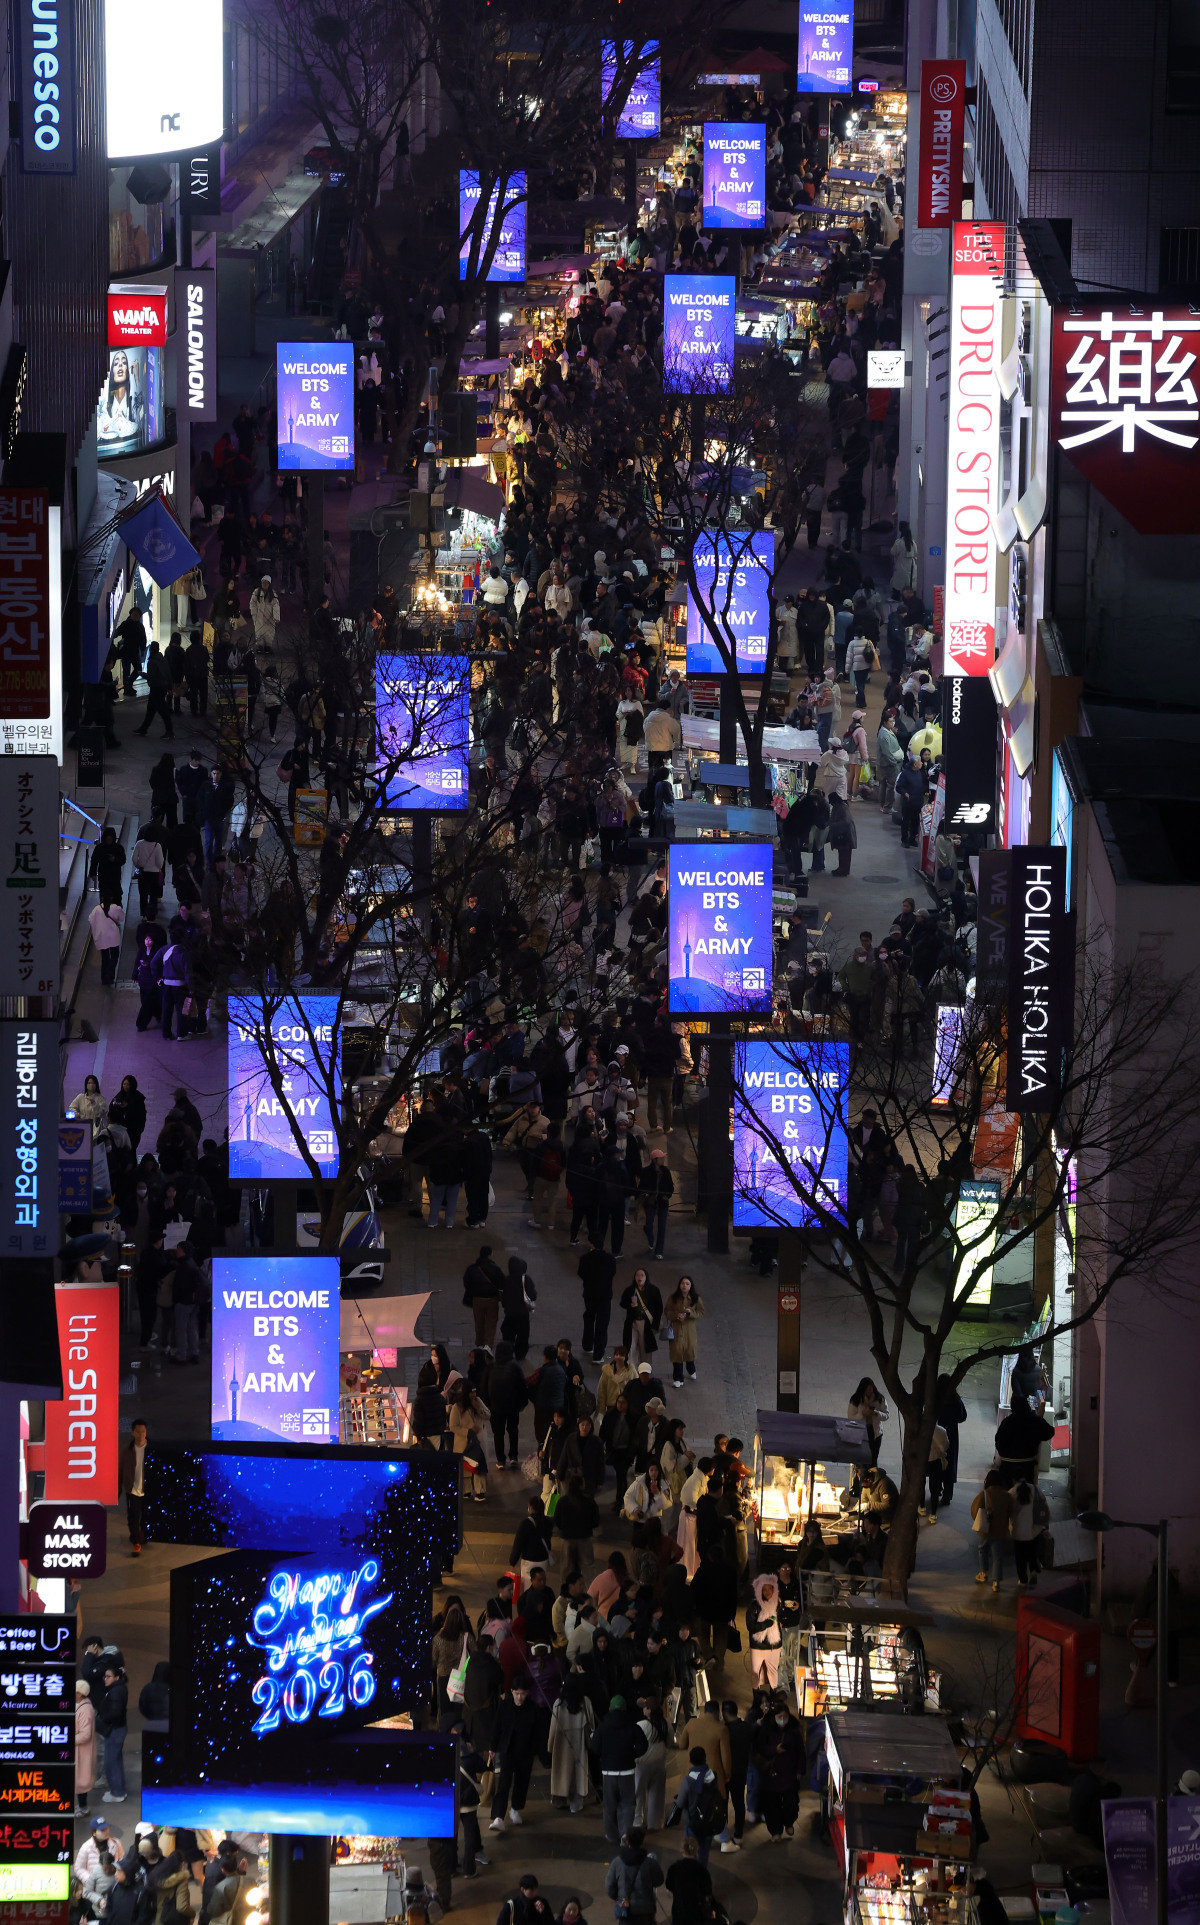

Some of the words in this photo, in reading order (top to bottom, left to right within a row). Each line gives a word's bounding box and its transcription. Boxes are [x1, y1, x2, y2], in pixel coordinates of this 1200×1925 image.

[803, 14, 850, 24] WELCOME
[816, 25, 836, 36] BTS
[822, 38, 830, 49] &
[810, 51, 843, 62] ARMY
[708, 139, 761, 150] WELCOME
[723, 152, 746, 164] BTS
[931, 109, 952, 219] PRETTYSKIN.
[190, 154, 209, 200] URY
[729, 167, 739, 179] &
[718, 181, 754, 193] ARMY
[963, 234, 993, 248] THE
[955, 249, 1003, 262] SEOUL
[669, 293, 730, 306] WELCOME
[112, 306, 160, 327] NANTA
[686, 308, 713, 322] BTS
[120, 327, 153, 336] THEATER
[693, 325, 704, 338] &
[187, 284, 205, 409] SALOMON
[680, 340, 722, 354] ARMY
[283, 363, 348, 375] WELCOME
[956, 304, 995, 433] DRUG
[301, 378, 330, 392] BTS
[1058, 310, 1200, 453] 藥
[310, 396, 321, 409] &
[295, 412, 340, 427] ARMY
[952, 450, 992, 596] STORE
[716, 572, 747, 587] BS
[0, 532, 45, 661] 부동산
[949, 619, 988, 658] 藥
[952, 676, 973, 726] balance
[16, 771, 34, 836] オアシス
[11, 841, 41, 875] 足
[677, 871, 765, 886] WELCOME
[702, 892, 740, 909] BTS
[714, 915, 728, 932] &
[1023, 865, 1052, 975] HOLIKA
[694, 936, 754, 955] ARMY
[38, 980, 54, 992] 8F
[1021, 985, 1049, 1096] HOLIKA
[15, 1032, 38, 1109] 김동진
[743, 1071, 840, 1088] WELCOME
[256, 1096, 321, 1117] ARMY
[771, 1094, 812, 1114] BTS
[783, 1120, 799, 1139] &
[761, 1145, 826, 1164] ARMY
[14, 1118, 40, 1228] 성형외과
[222, 1290, 330, 1309] WELCOME
[252, 1315, 299, 1337] BTS
[68, 1314, 97, 1361] the
[267, 1345, 285, 1365] &
[242, 1371, 317, 1393] ARMY
[279, 1422, 301, 1432] 1545
[53, 1515, 84, 1530] ALL
[44, 1535, 91, 1549] MASK
[42, 1553, 92, 1569] STORY
[0, 1628, 37, 1639] Coffee
[9, 1641, 37, 1651] Beer
[1, 1673, 65, 1697] 방탈출
[251, 1653, 377, 1733] 2026
[0, 1725, 69, 1745] 보드게임
[17, 1771, 44, 1786] WE
[58, 1802, 70, 1811] 6F
